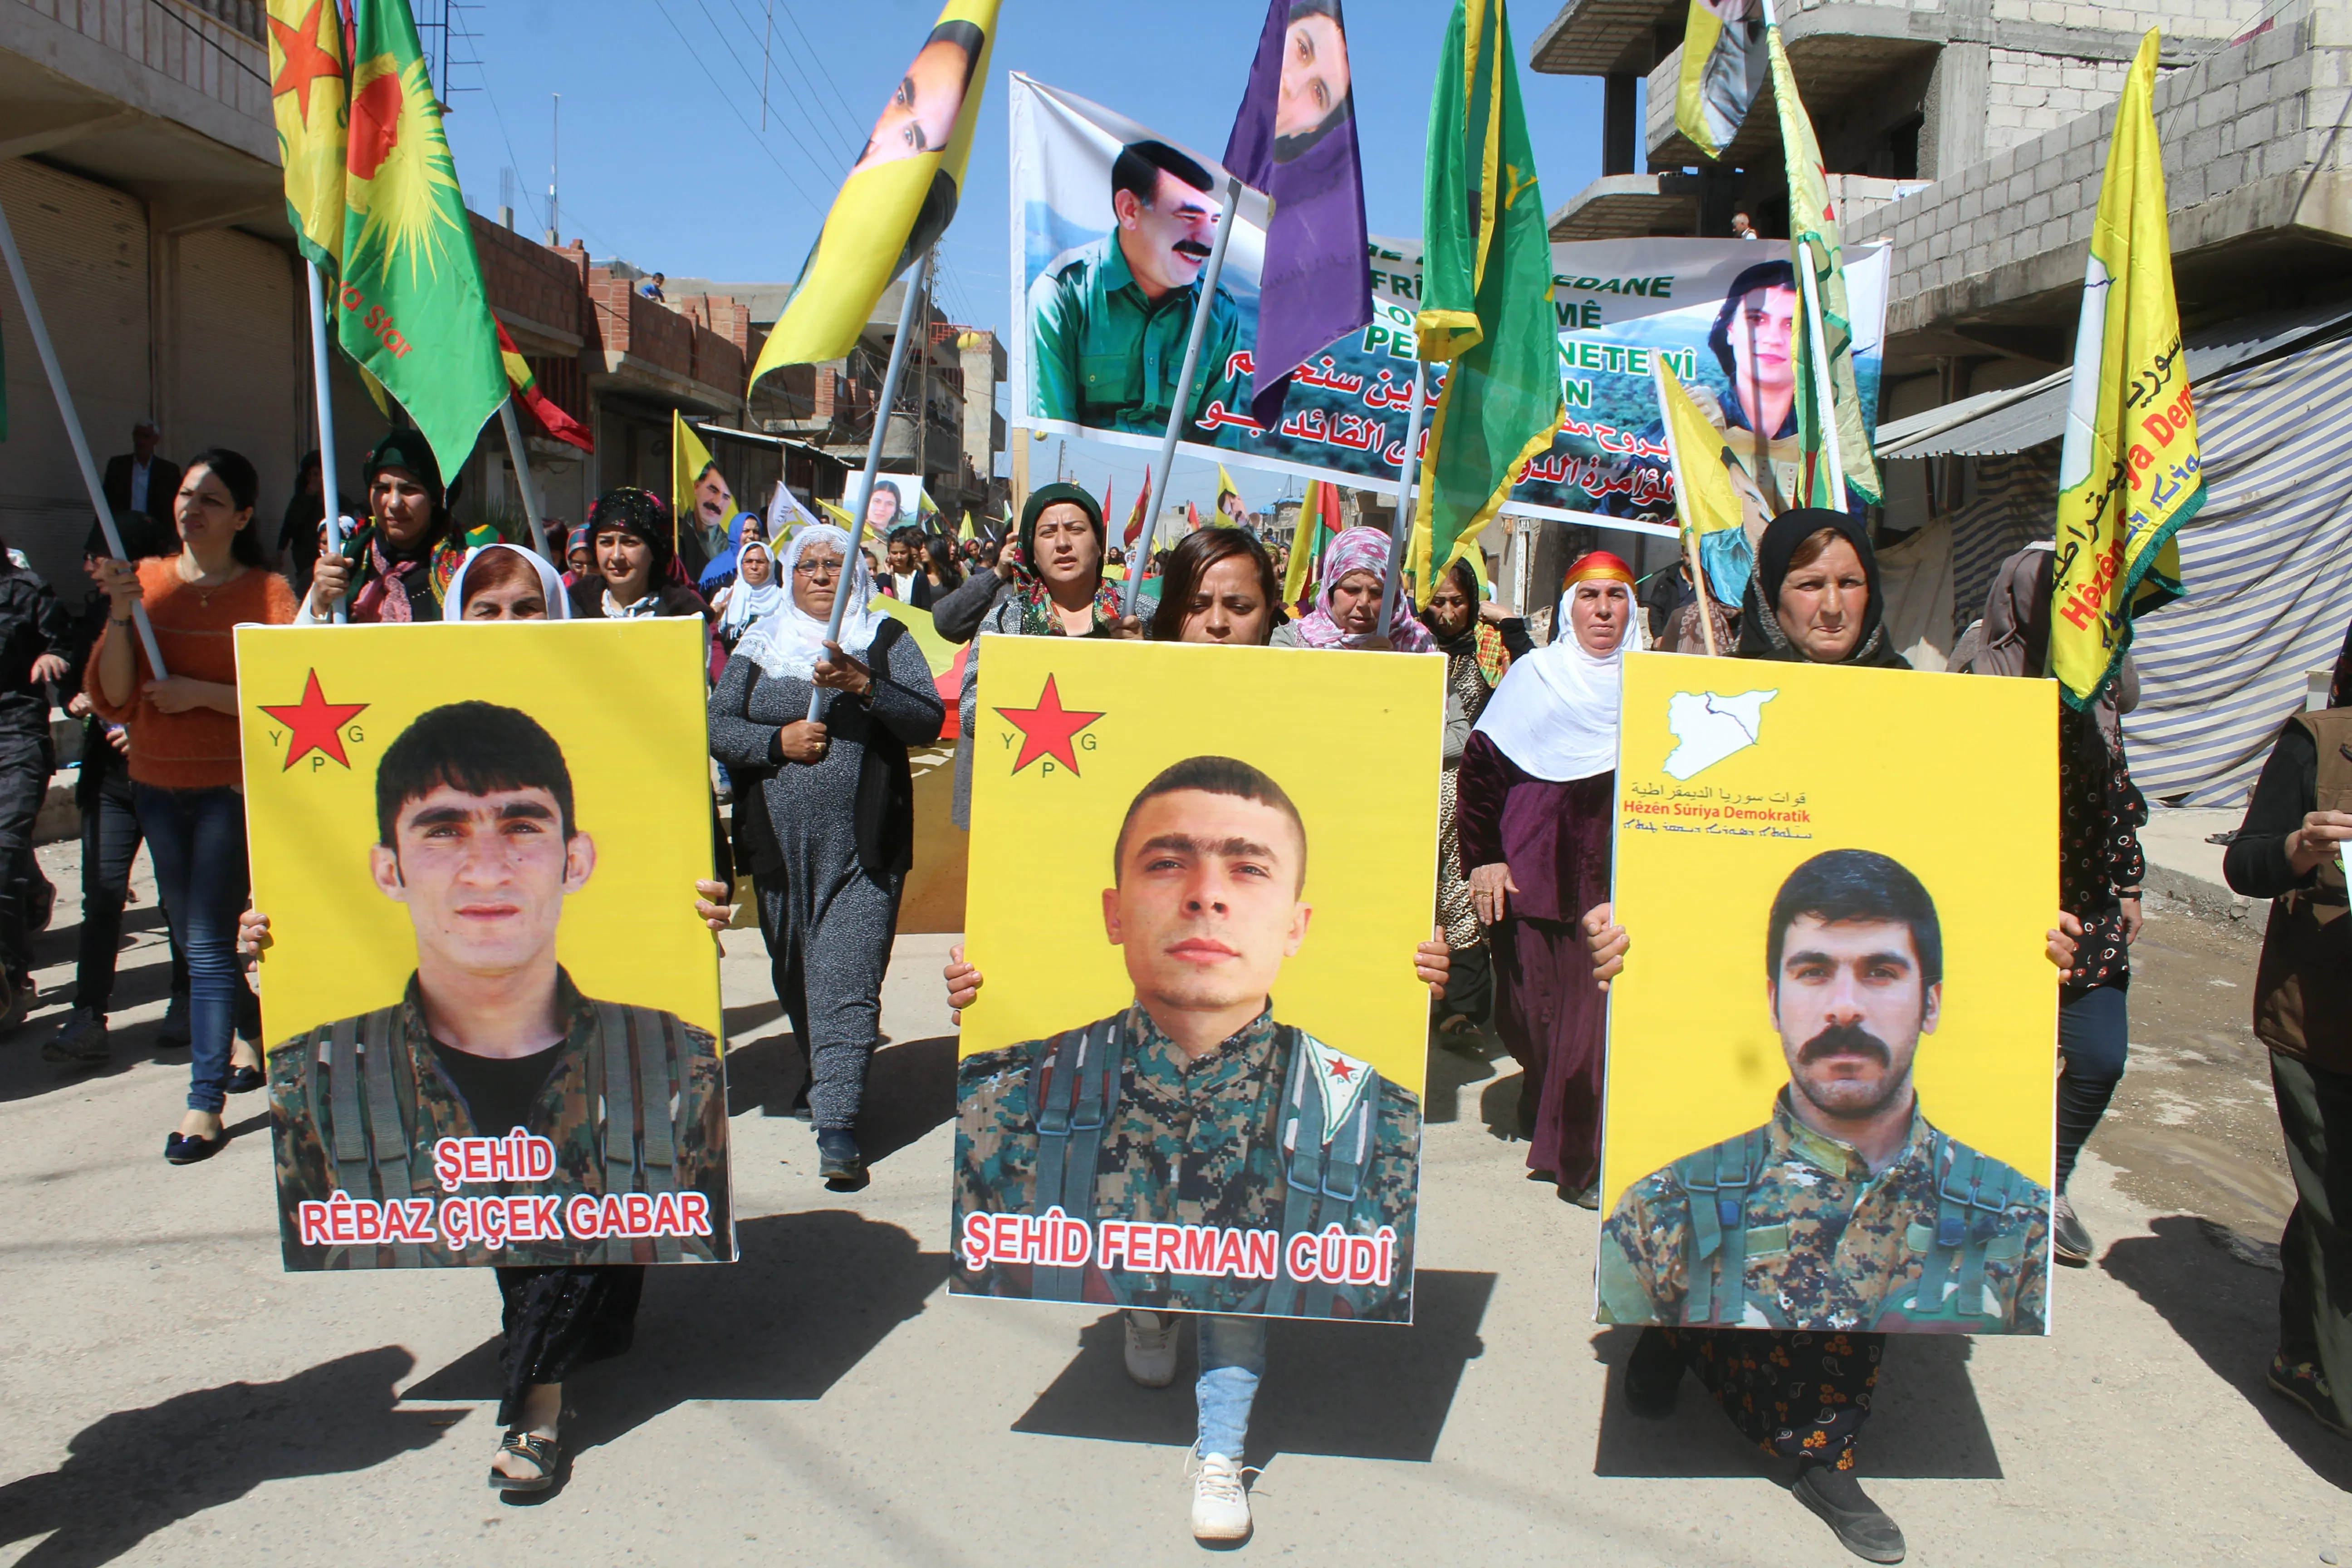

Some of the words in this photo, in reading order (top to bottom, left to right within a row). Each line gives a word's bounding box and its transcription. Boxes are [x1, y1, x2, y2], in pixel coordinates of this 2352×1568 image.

[363, 305, 413, 359] Star
[1280, 409, 1385, 453] القائد
[2060, 539, 2125, 632] Hêzên
[1624, 799, 1670, 815] Hêzên
[1631, 782, 1713, 801] الديمقراطية
[1719, 788, 1763, 804] سوريا
[1768, 792, 1806, 807] قوات
[438, 1128, 554, 1188] ŞEHÎD
[303, 1193, 433, 1241] RÊBAZ
[442, 1198, 561, 1247] ÇIÇEK
[570, 1196, 710, 1236] GABAR
[966, 1209, 1088, 1267] ŞEHÎD
[1102, 1224, 1276, 1276] FERMAN
[1289, 1226, 1395, 1283] CÛDÎ
